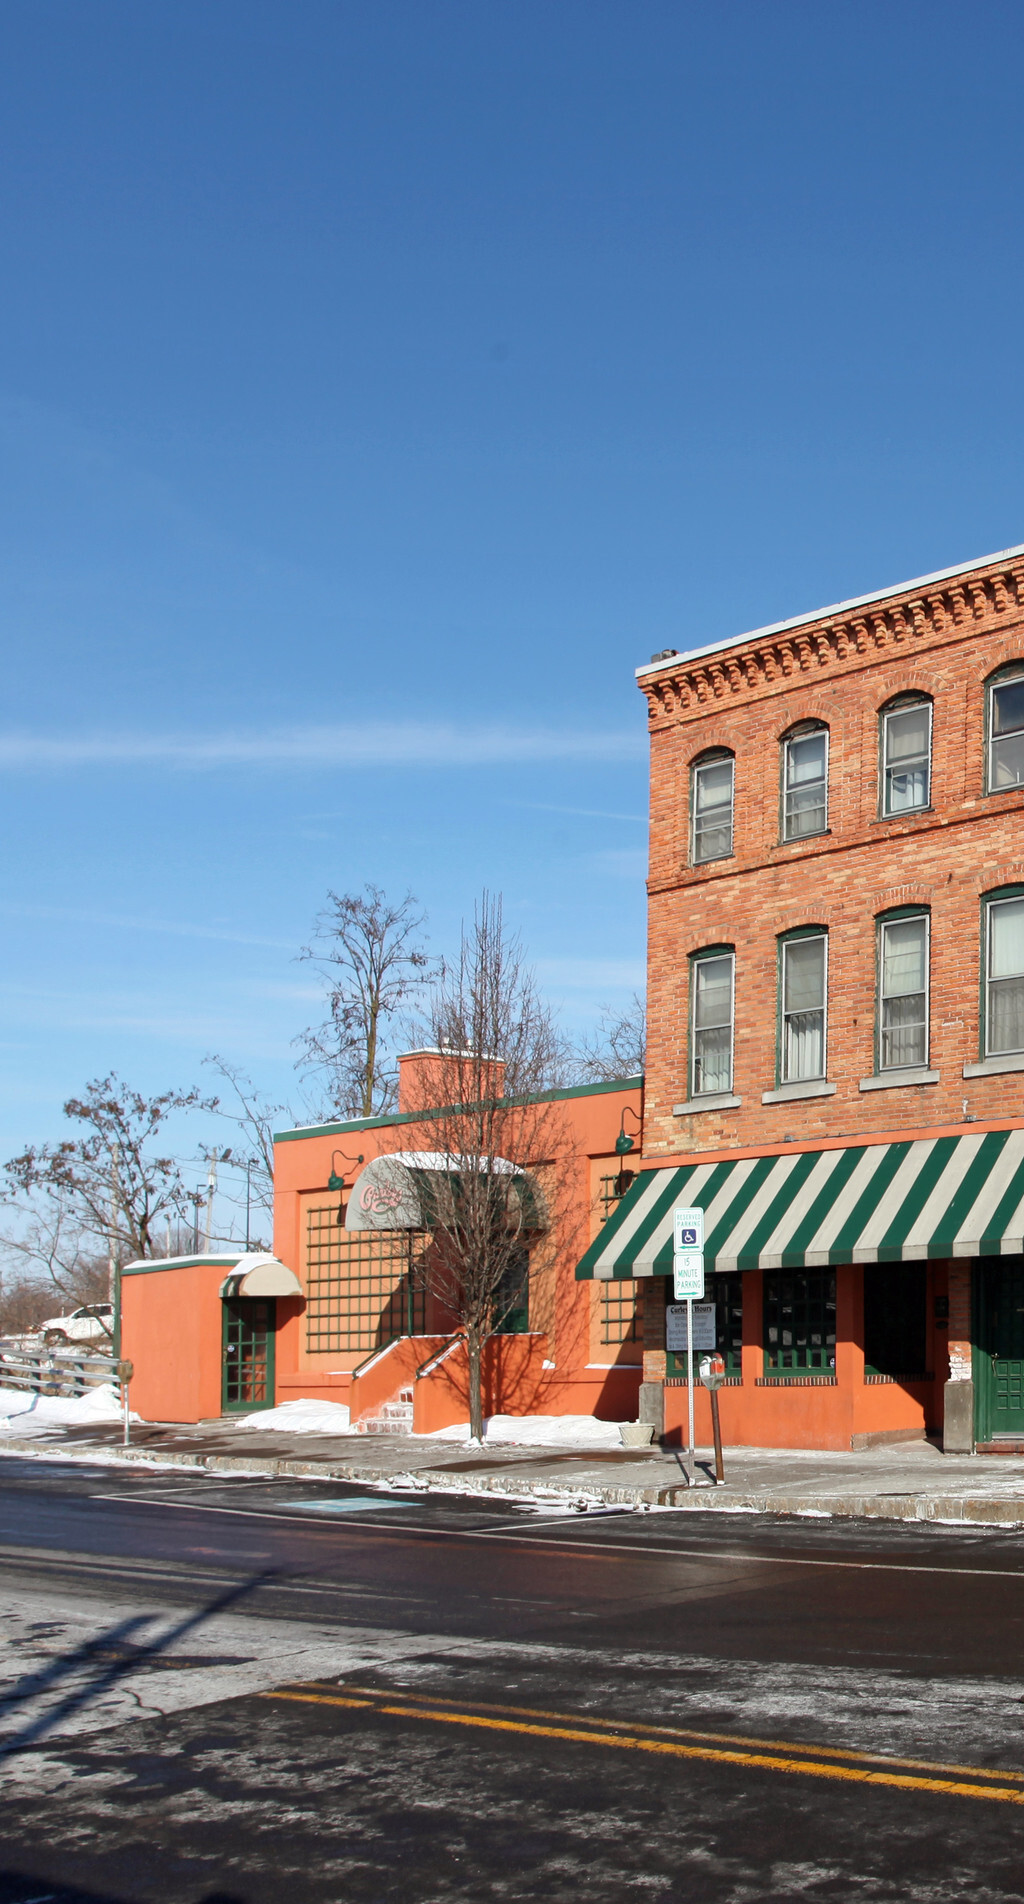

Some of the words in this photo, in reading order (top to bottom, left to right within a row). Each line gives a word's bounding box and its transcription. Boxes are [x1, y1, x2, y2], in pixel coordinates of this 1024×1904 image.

[684, 1257, 690, 1266] 15
[678, 1269, 698, 1278] MINUTE
[677, 1281, 701, 1289] PARKING
[694, 1305, 712, 1313] Hours
